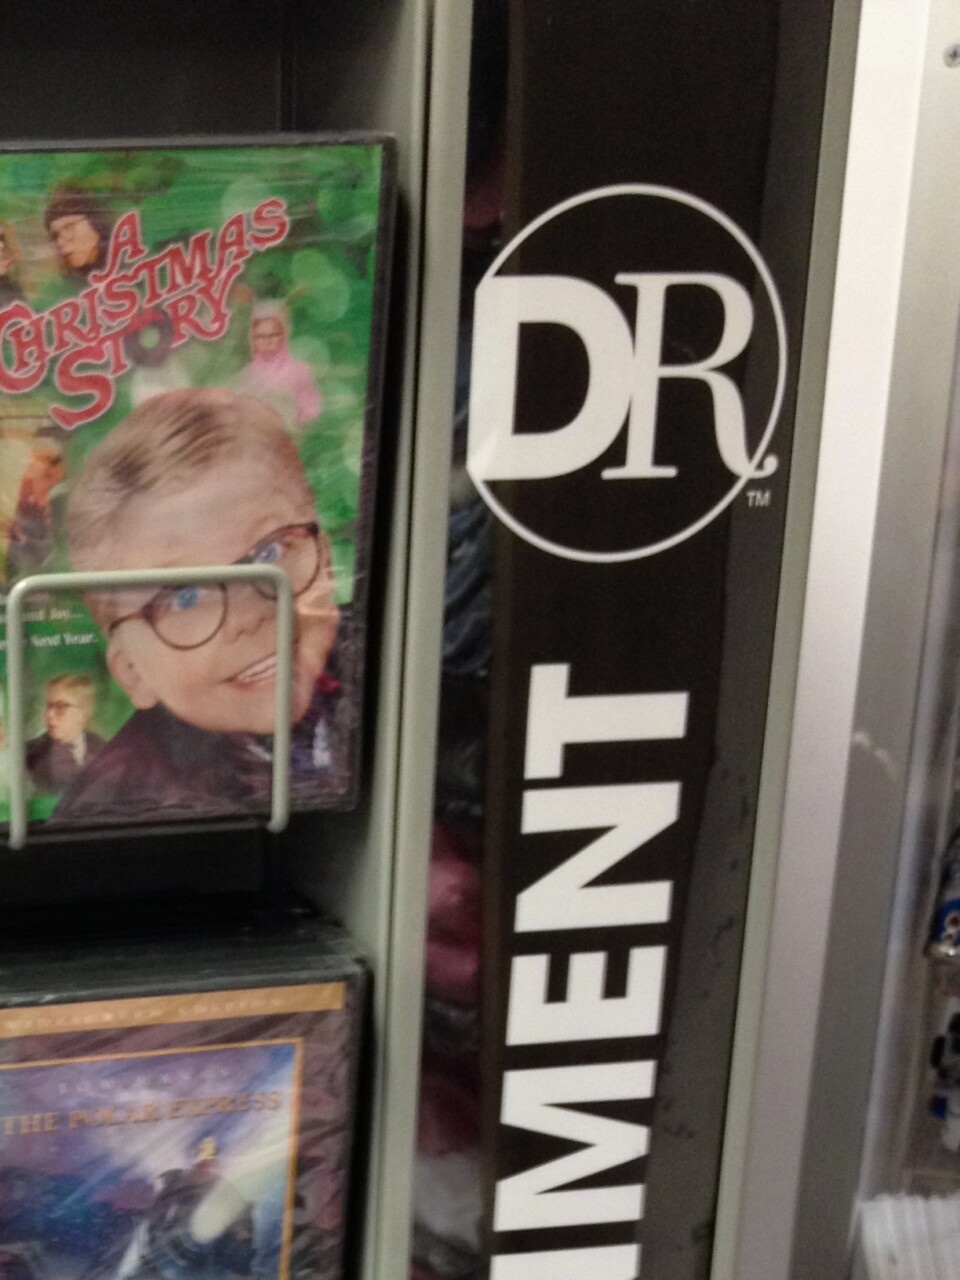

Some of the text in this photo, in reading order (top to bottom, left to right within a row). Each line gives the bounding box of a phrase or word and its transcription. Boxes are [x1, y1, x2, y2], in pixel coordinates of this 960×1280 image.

[91, 211, 146, 284] A
[746, 491, 771, 507] TM
[0, 1112, 58, 1136] THE
[168, 1091, 281, 1119] EXPRESS
